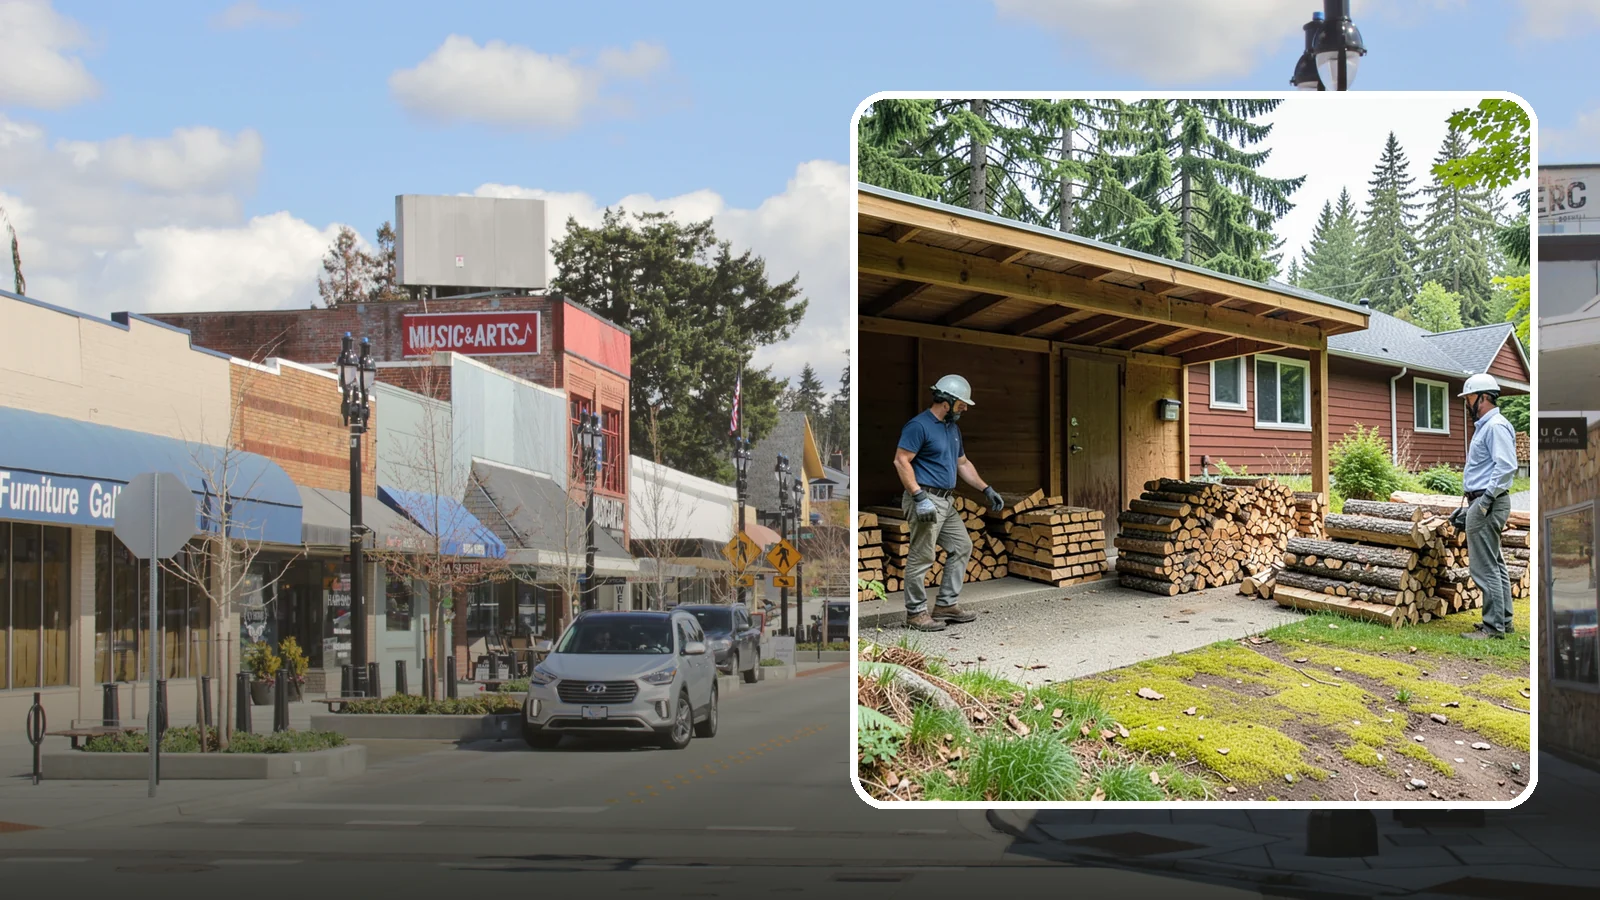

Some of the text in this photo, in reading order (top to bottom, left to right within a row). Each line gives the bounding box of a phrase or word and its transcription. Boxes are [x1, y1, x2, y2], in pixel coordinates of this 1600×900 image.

[409, 323, 520, 349] MUSIC&ARTS
[1551, 436, 1579, 444] Framing
[0, 471, 122, 519] Furniture Gal
[453, 563, 479, 574] SUSHI
